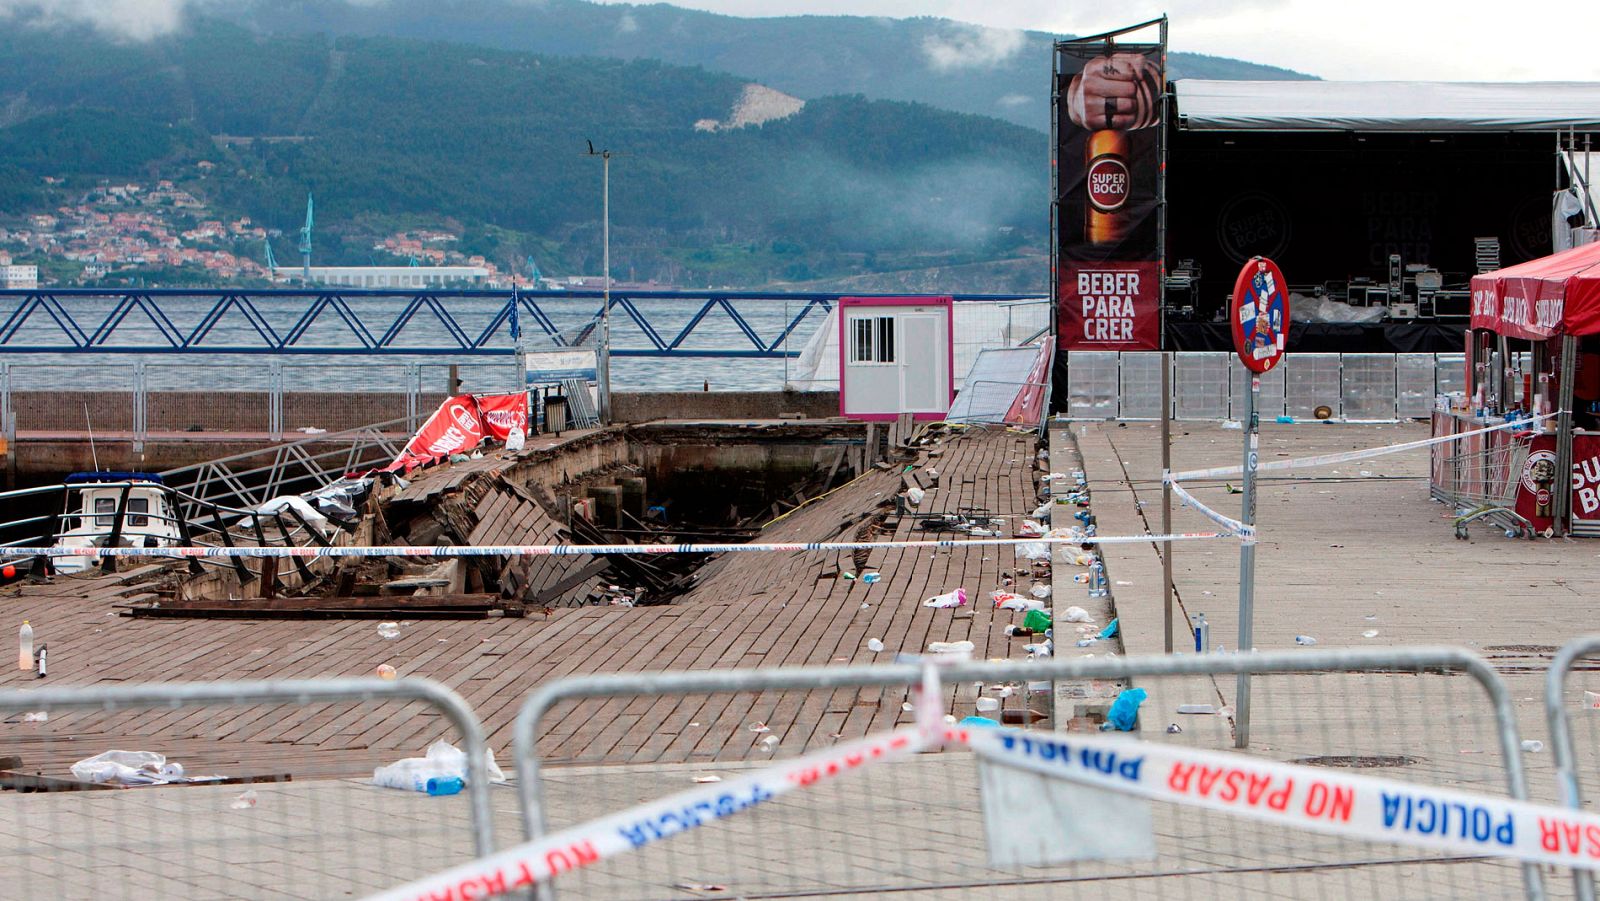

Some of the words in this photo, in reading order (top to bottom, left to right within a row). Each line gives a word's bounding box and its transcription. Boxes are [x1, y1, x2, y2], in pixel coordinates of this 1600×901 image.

[1092, 173, 1126, 184] SUPER
[1093, 183, 1124, 194] BOCK
[1078, 273, 1140, 295] BEBER
[1082, 296, 1136, 318] PARA
[1084, 318, 1134, 340] CRER
[1167, 760, 1294, 814] PASAR
[1304, 780, 1356, 824] NO
[1380, 790, 1515, 848] POLICIA
